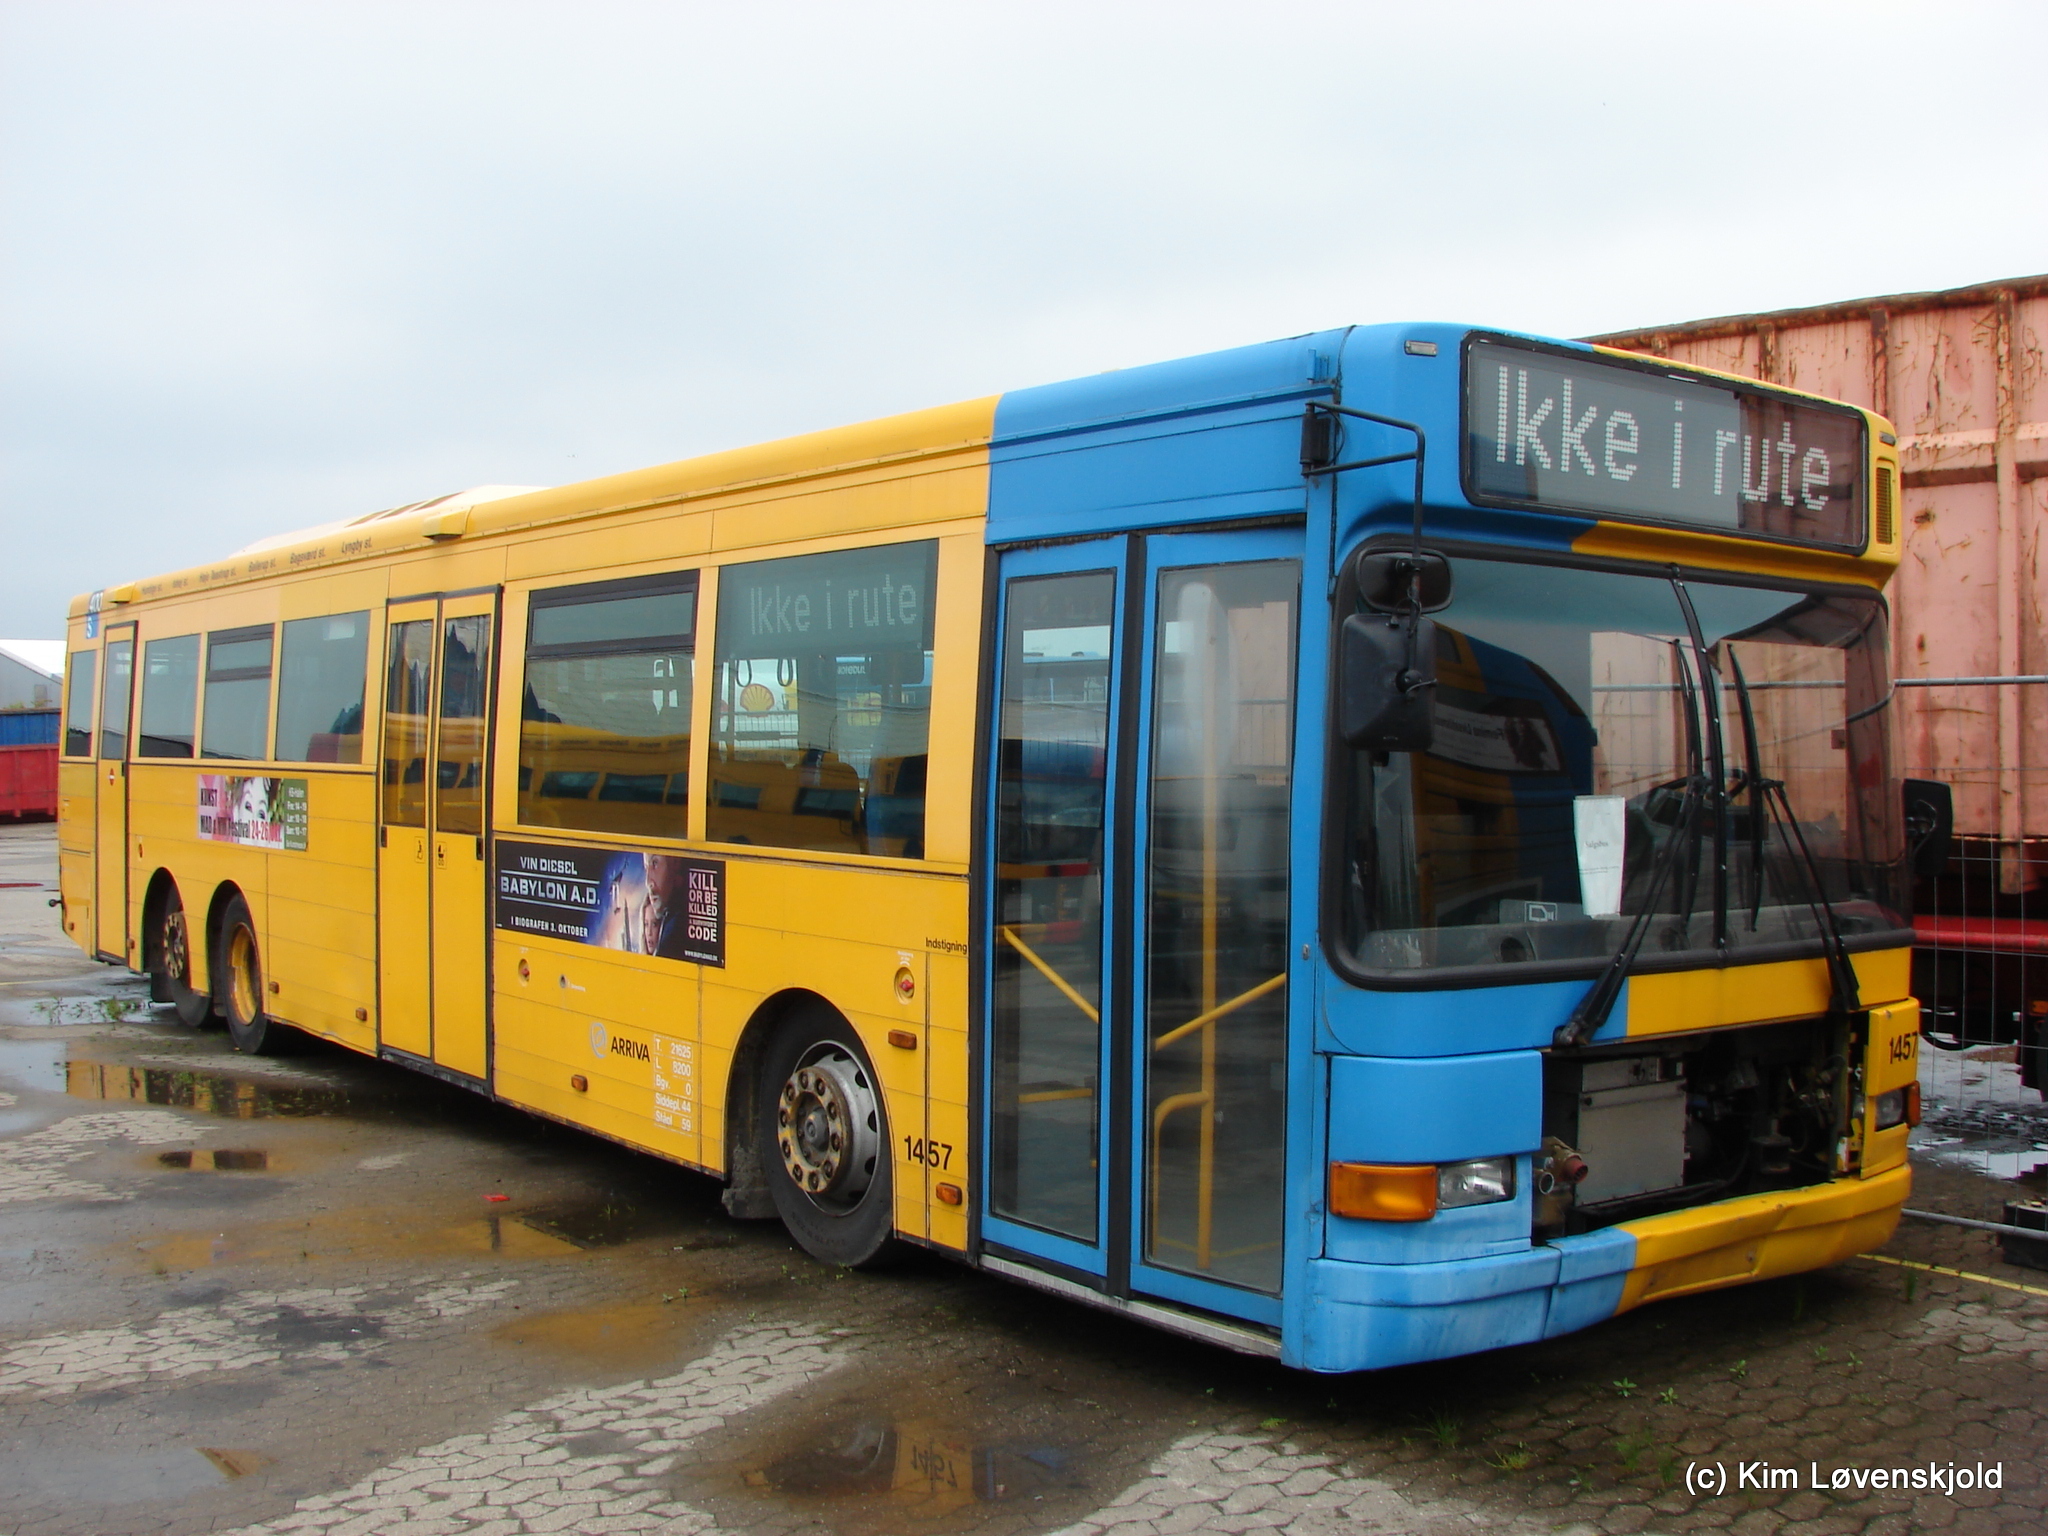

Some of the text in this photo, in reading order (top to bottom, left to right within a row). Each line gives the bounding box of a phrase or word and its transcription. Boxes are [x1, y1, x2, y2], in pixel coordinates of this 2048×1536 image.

[1496, 366, 1830, 511] Ikke i rute
[750, 574, 918, 635] Ikke i rute
[520, 856, 578, 875] VIN DIESEL
[500, 876, 600, 905] BABYLON A.D.
[689, 872, 718, 892] KILL
[688, 889, 718, 905] OR BE
[688, 903, 718, 917] KILLED
[511, 916, 514, 924] I
[515, 916, 549, 931] BIOGRAFEN
[550, 923, 557, 932] 3.
[558, 924, 588, 937] OKTOBER
[688, 925, 717, 942] CODE
[925, 937, 968, 955] Indstigning
[611, 1036, 650, 1063] ARRIVA
[1889, 1031, 1918, 1064] 1457
[685, 1083, 691, 1095] 0
[681, 1100, 691, 1113] 44
[681, 1118, 691, 1132] 59
[904, 1135, 952, 1170] 1457
